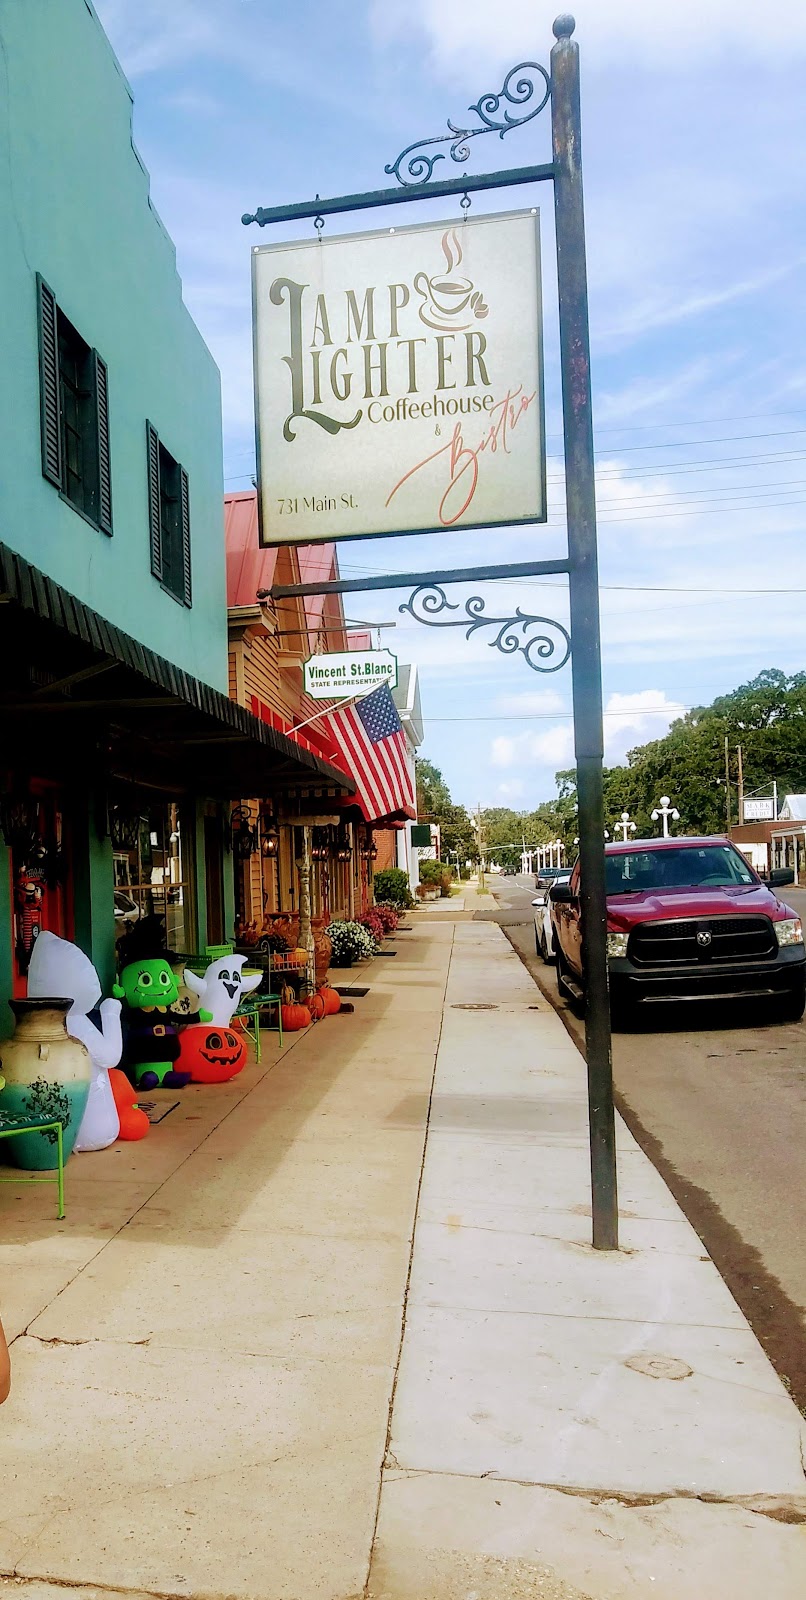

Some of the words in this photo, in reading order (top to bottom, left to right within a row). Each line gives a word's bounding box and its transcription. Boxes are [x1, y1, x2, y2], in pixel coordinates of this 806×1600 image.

[269, 277, 411, 348] LAMP
[281, 331, 492, 442] LIGHTER
[367, 394, 494, 424] Coffeehouse
[434, 423, 442, 437] &
[385, 384, 537, 525] Bistro
[277, 498, 299, 515] 731
[303, 495, 337, 513] Main
[340, 492, 359, 510] St.
[309, 665, 346, 678] Vincent
